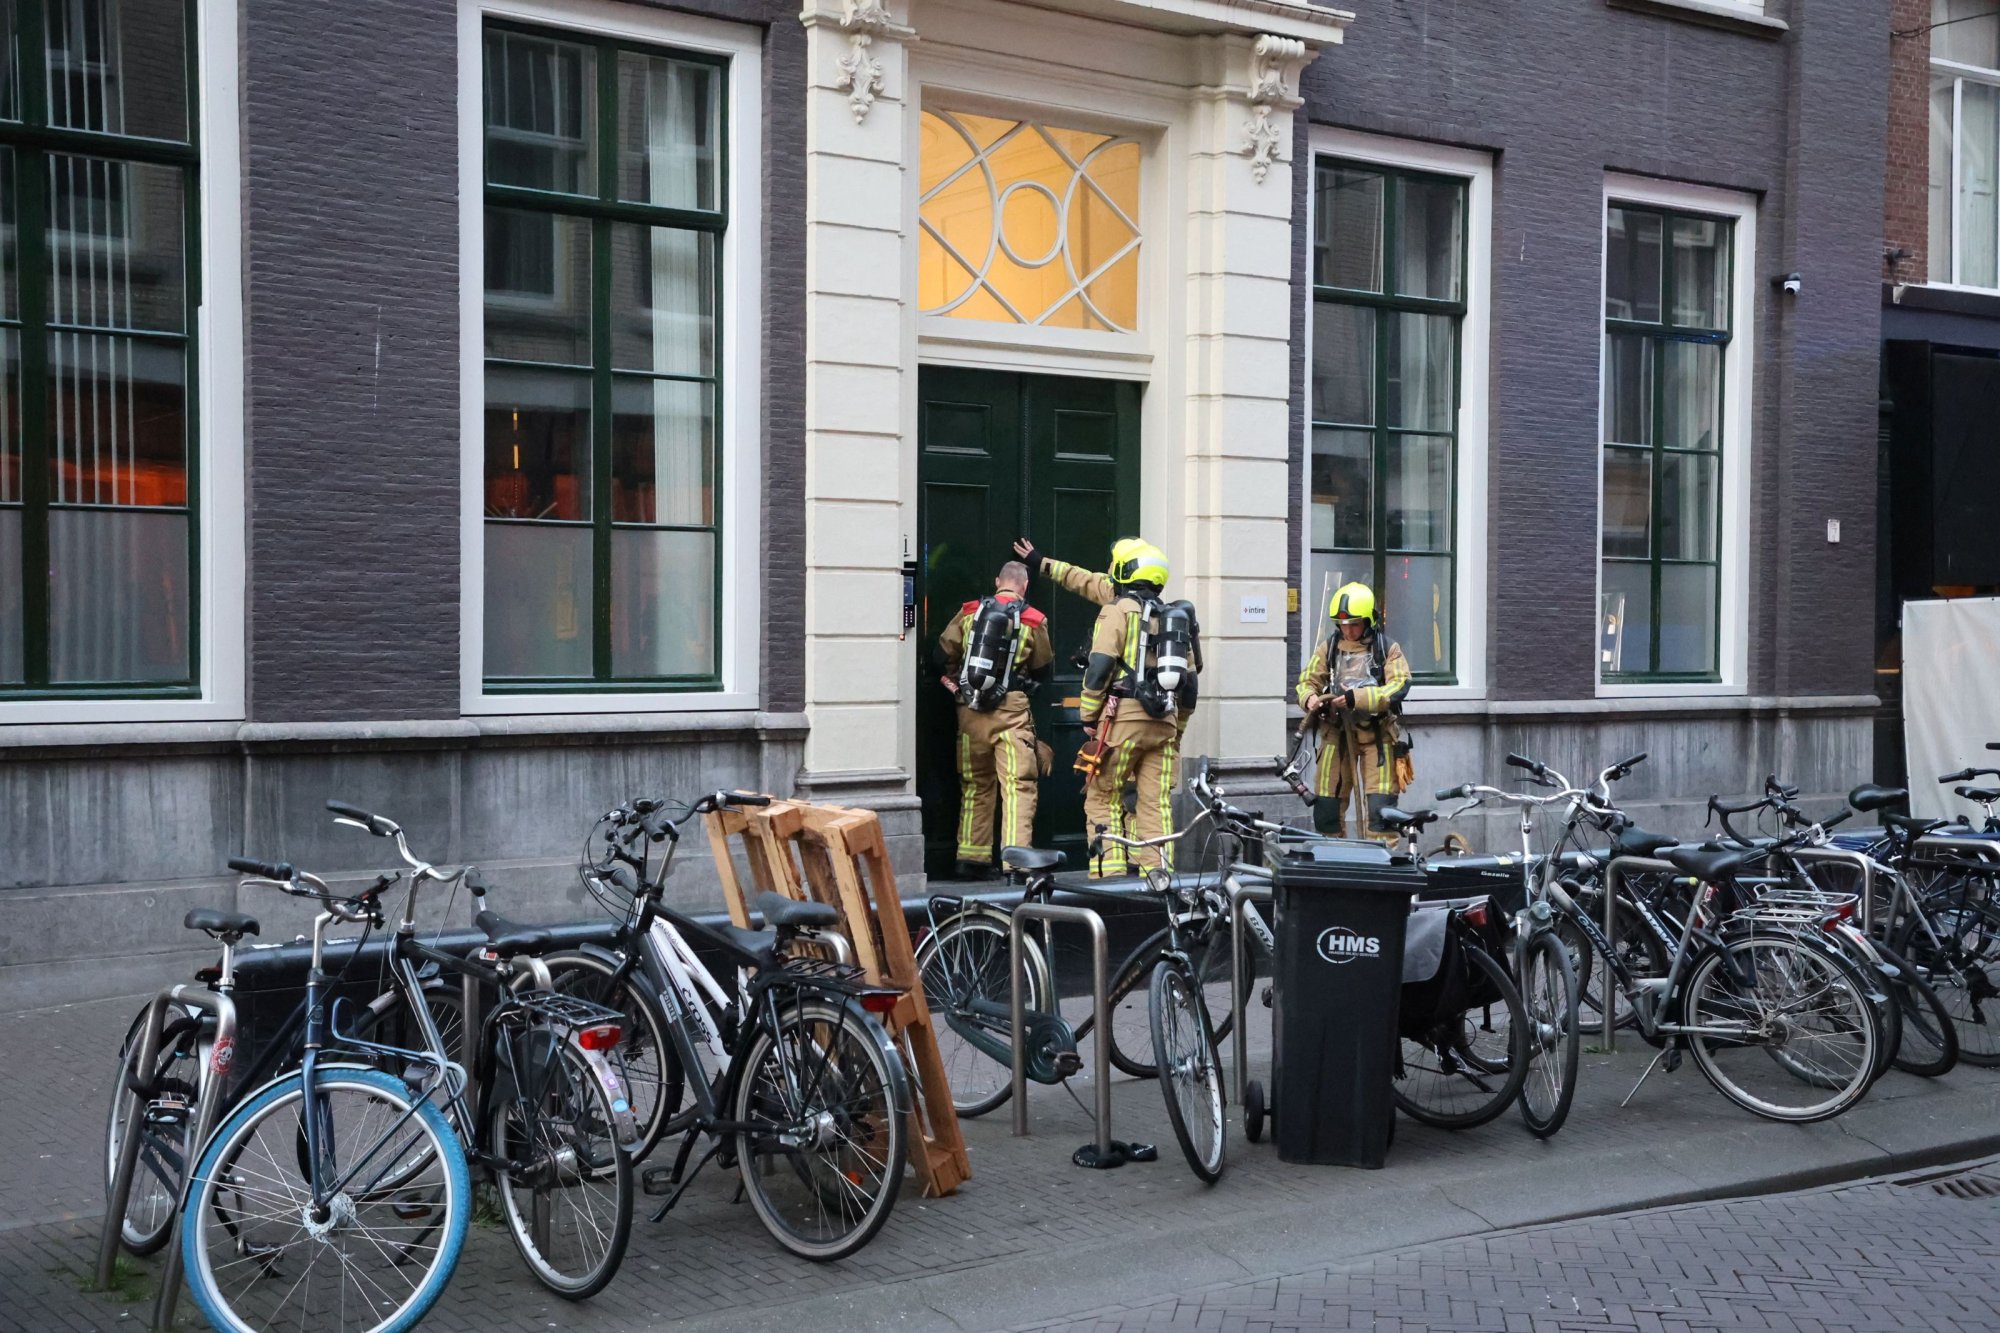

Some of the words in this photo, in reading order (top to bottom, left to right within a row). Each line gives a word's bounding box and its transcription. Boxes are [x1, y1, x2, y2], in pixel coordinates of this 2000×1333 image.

[1248, 606, 1266, 614] intire
[1577, 915, 1618, 967] Gazelle
[1635, 900, 1679, 953] BATAVU
[1328, 934, 1380, 954] HMS
[662, 989, 678, 1021] POINTER
